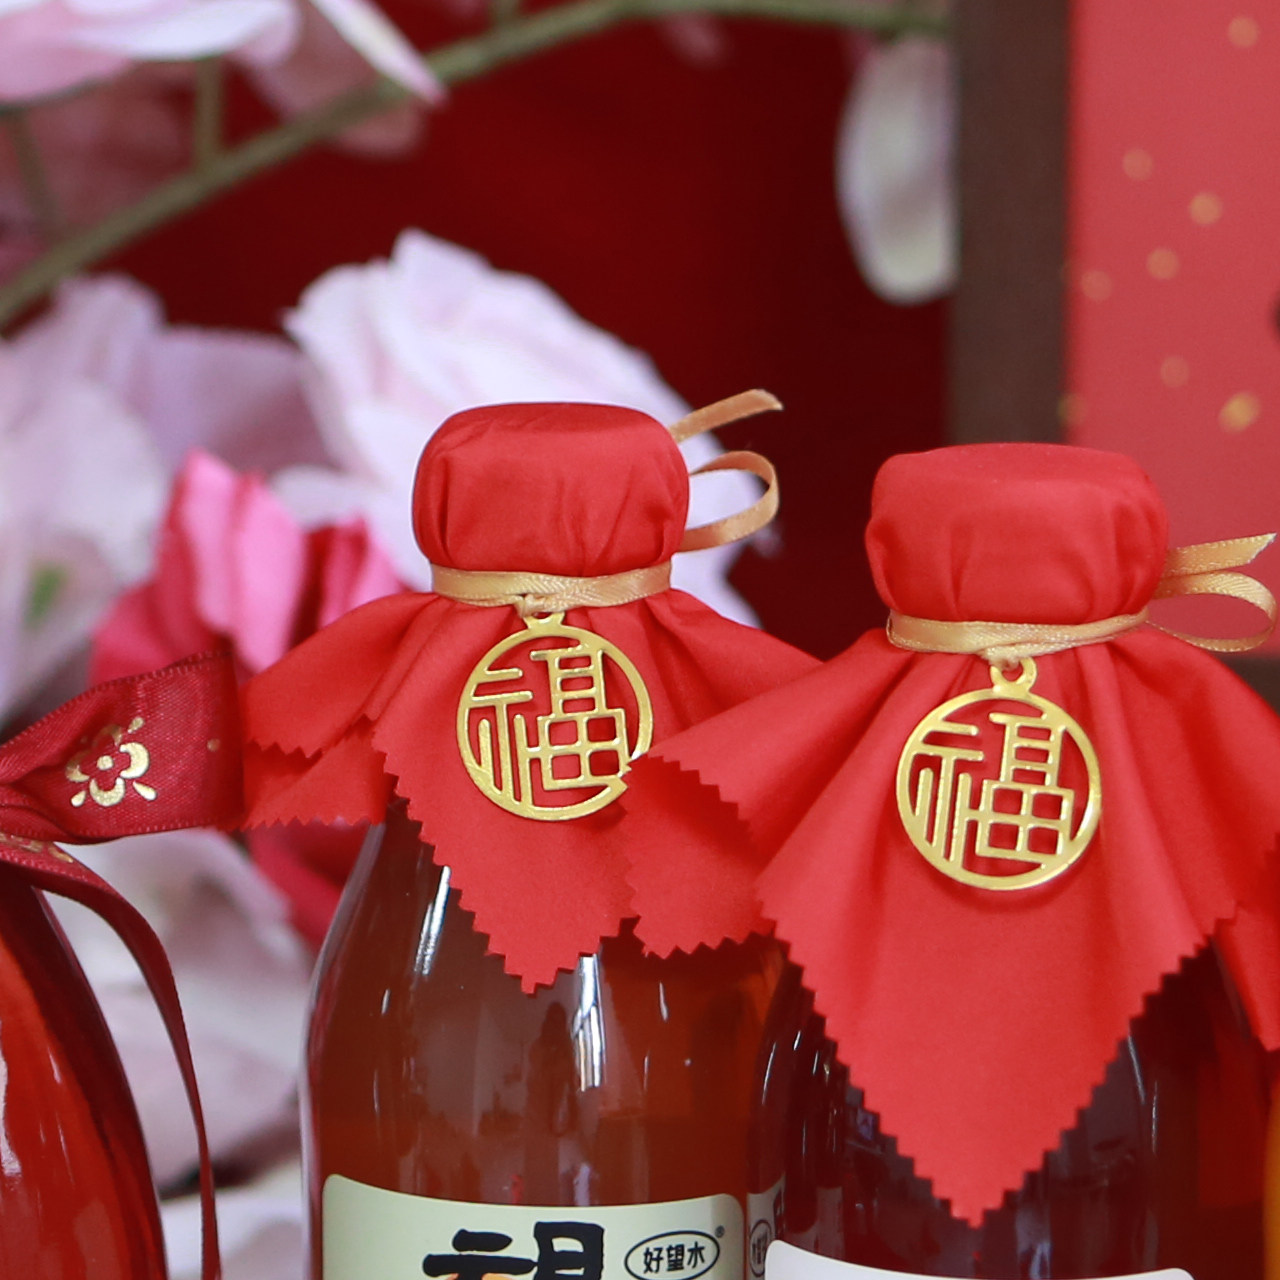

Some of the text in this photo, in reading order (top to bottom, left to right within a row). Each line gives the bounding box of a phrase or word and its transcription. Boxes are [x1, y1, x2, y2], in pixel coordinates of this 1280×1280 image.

[462, 642, 632, 818] 福
[904, 710, 1088, 872] 福
[642, 1240, 706, 1275] 好望水
